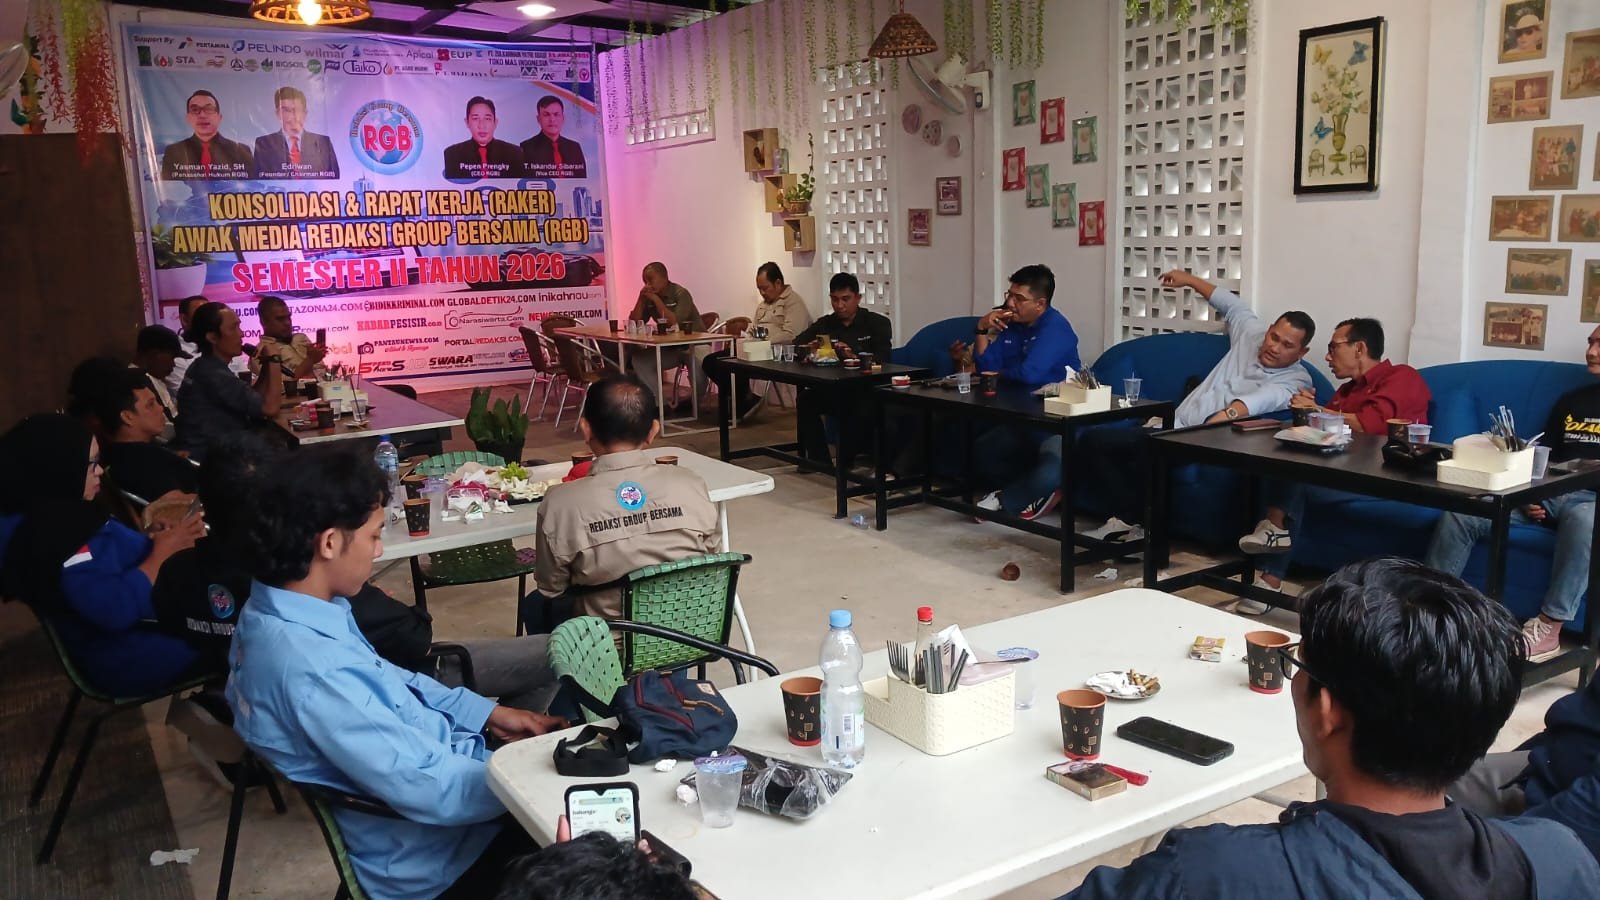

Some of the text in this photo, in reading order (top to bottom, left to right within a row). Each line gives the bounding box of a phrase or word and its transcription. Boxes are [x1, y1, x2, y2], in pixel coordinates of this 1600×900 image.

[248, 43, 301, 53] PELINDO
[304, 47, 345, 59] wilmar
[450, 50, 472, 59] EUP
[176, 56, 195, 64] STA
[347, 60, 376, 73] Taiko
[363, 124, 413, 152] RGB
[459, 162, 510, 171] Pepen Prengky
[208, 189, 556, 220] KONSOLIDASI & RAPAT KERJA (RAKER)
[173, 217, 589, 253] AWAK MEDIA REDAKSI GROUP BERSAMA (RGB)
[232, 252, 566, 293] SEMESTER II TAHUN 2026
[447, 294, 536, 307] GLOBALDETIK24.COM
[429, 355, 474, 366] SWARA
[589, 506, 683, 533] REDAKSI GROUP BERSAMA
